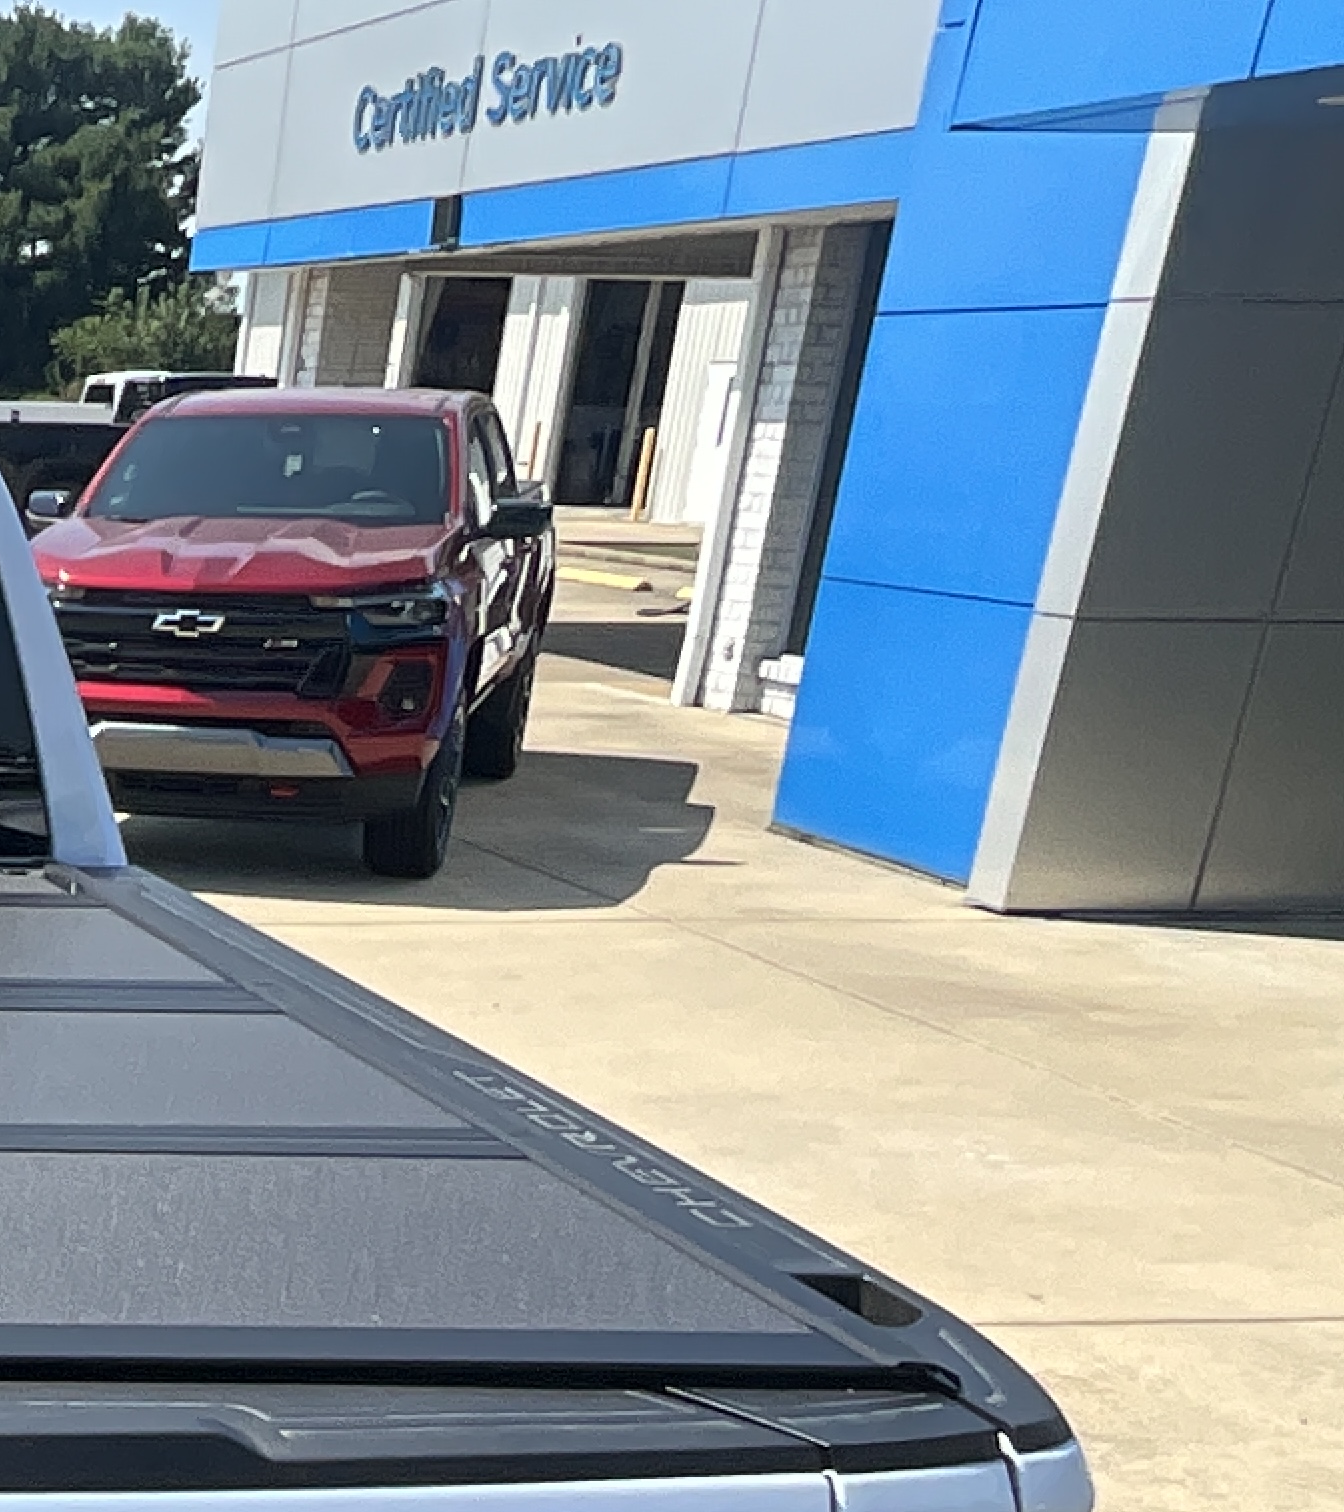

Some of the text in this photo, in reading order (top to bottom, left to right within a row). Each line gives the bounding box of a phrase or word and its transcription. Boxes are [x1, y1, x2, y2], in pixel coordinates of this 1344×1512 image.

[353, 35, 624, 155] Certified Service
[452, 1070, 754, 1228] CHEVROLET
